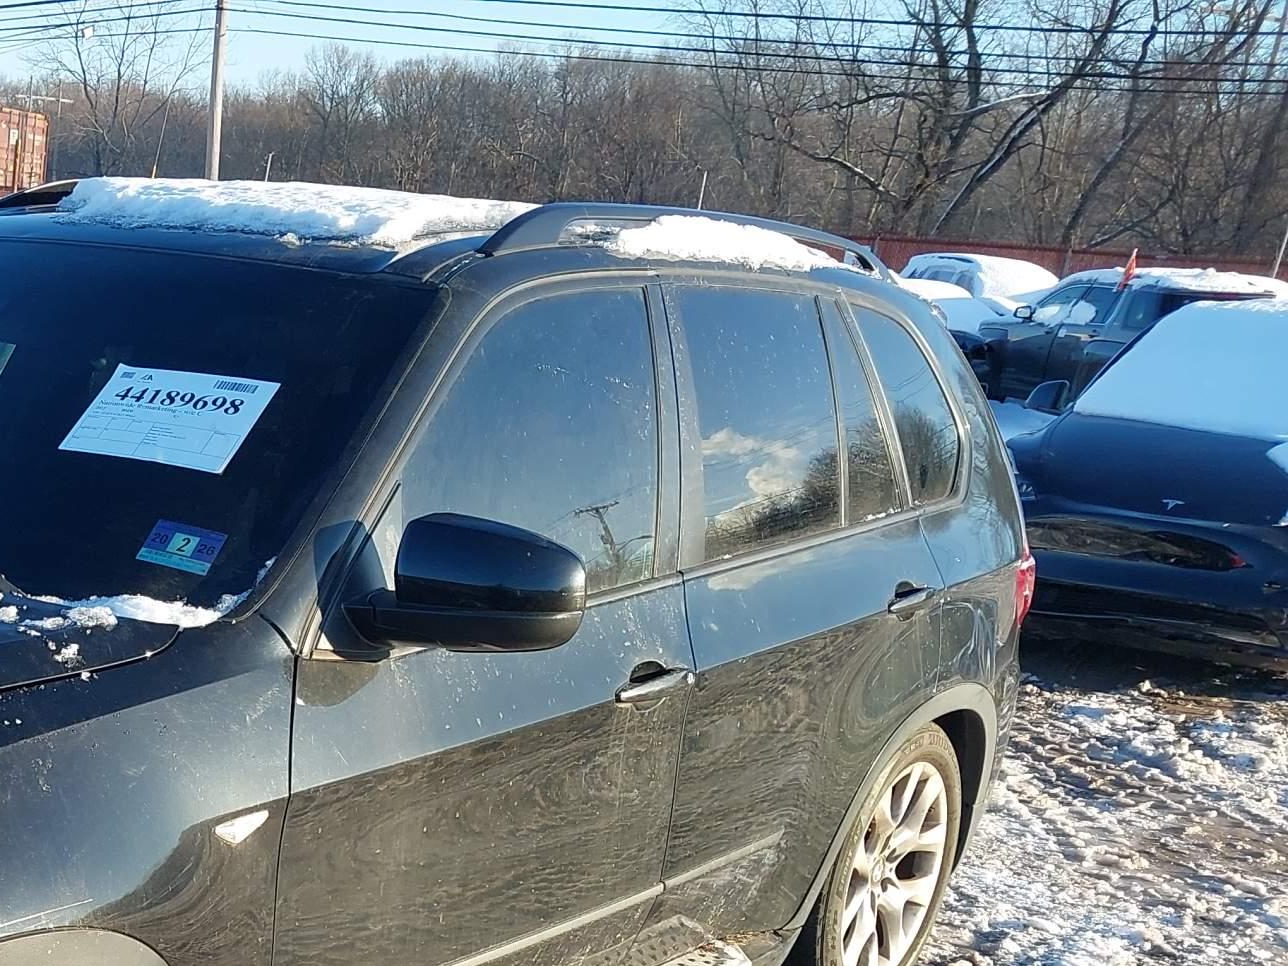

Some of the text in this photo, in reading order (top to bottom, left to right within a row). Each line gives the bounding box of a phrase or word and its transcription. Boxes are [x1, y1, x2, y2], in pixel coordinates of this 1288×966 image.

[115, 386, 245, 415] 44189698
[152, 533, 216, 556] 20 2 26
